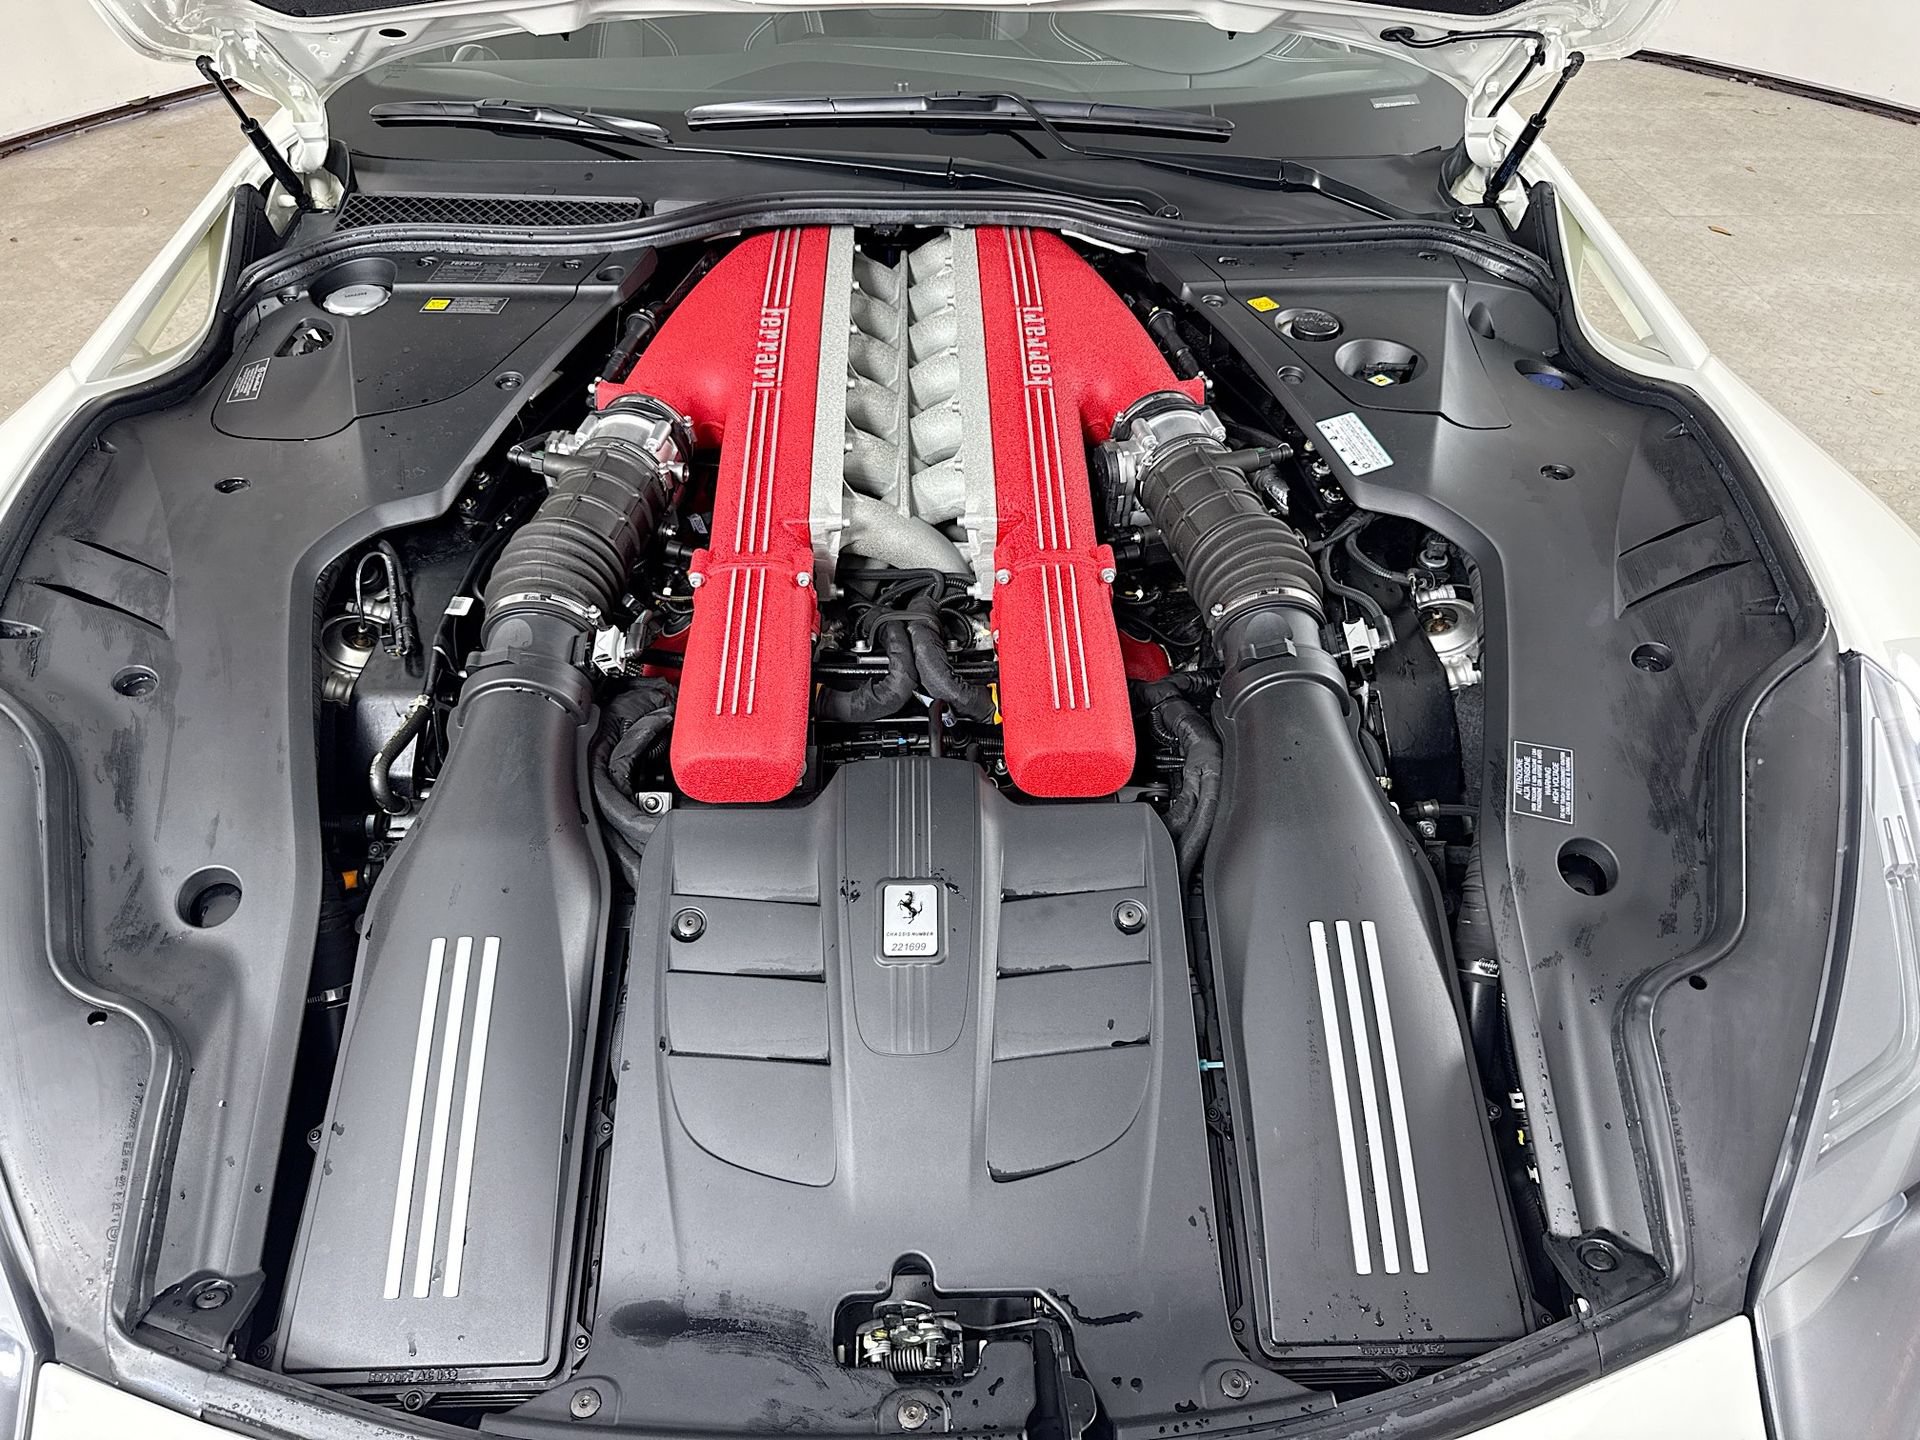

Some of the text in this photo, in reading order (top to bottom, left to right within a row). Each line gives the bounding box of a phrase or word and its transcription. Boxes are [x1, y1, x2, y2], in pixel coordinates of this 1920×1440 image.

[752, 307, 789, 388] Ferrari
[1016, 306, 1053, 387] Ferrari
[891, 942, 927, 951] 221699
